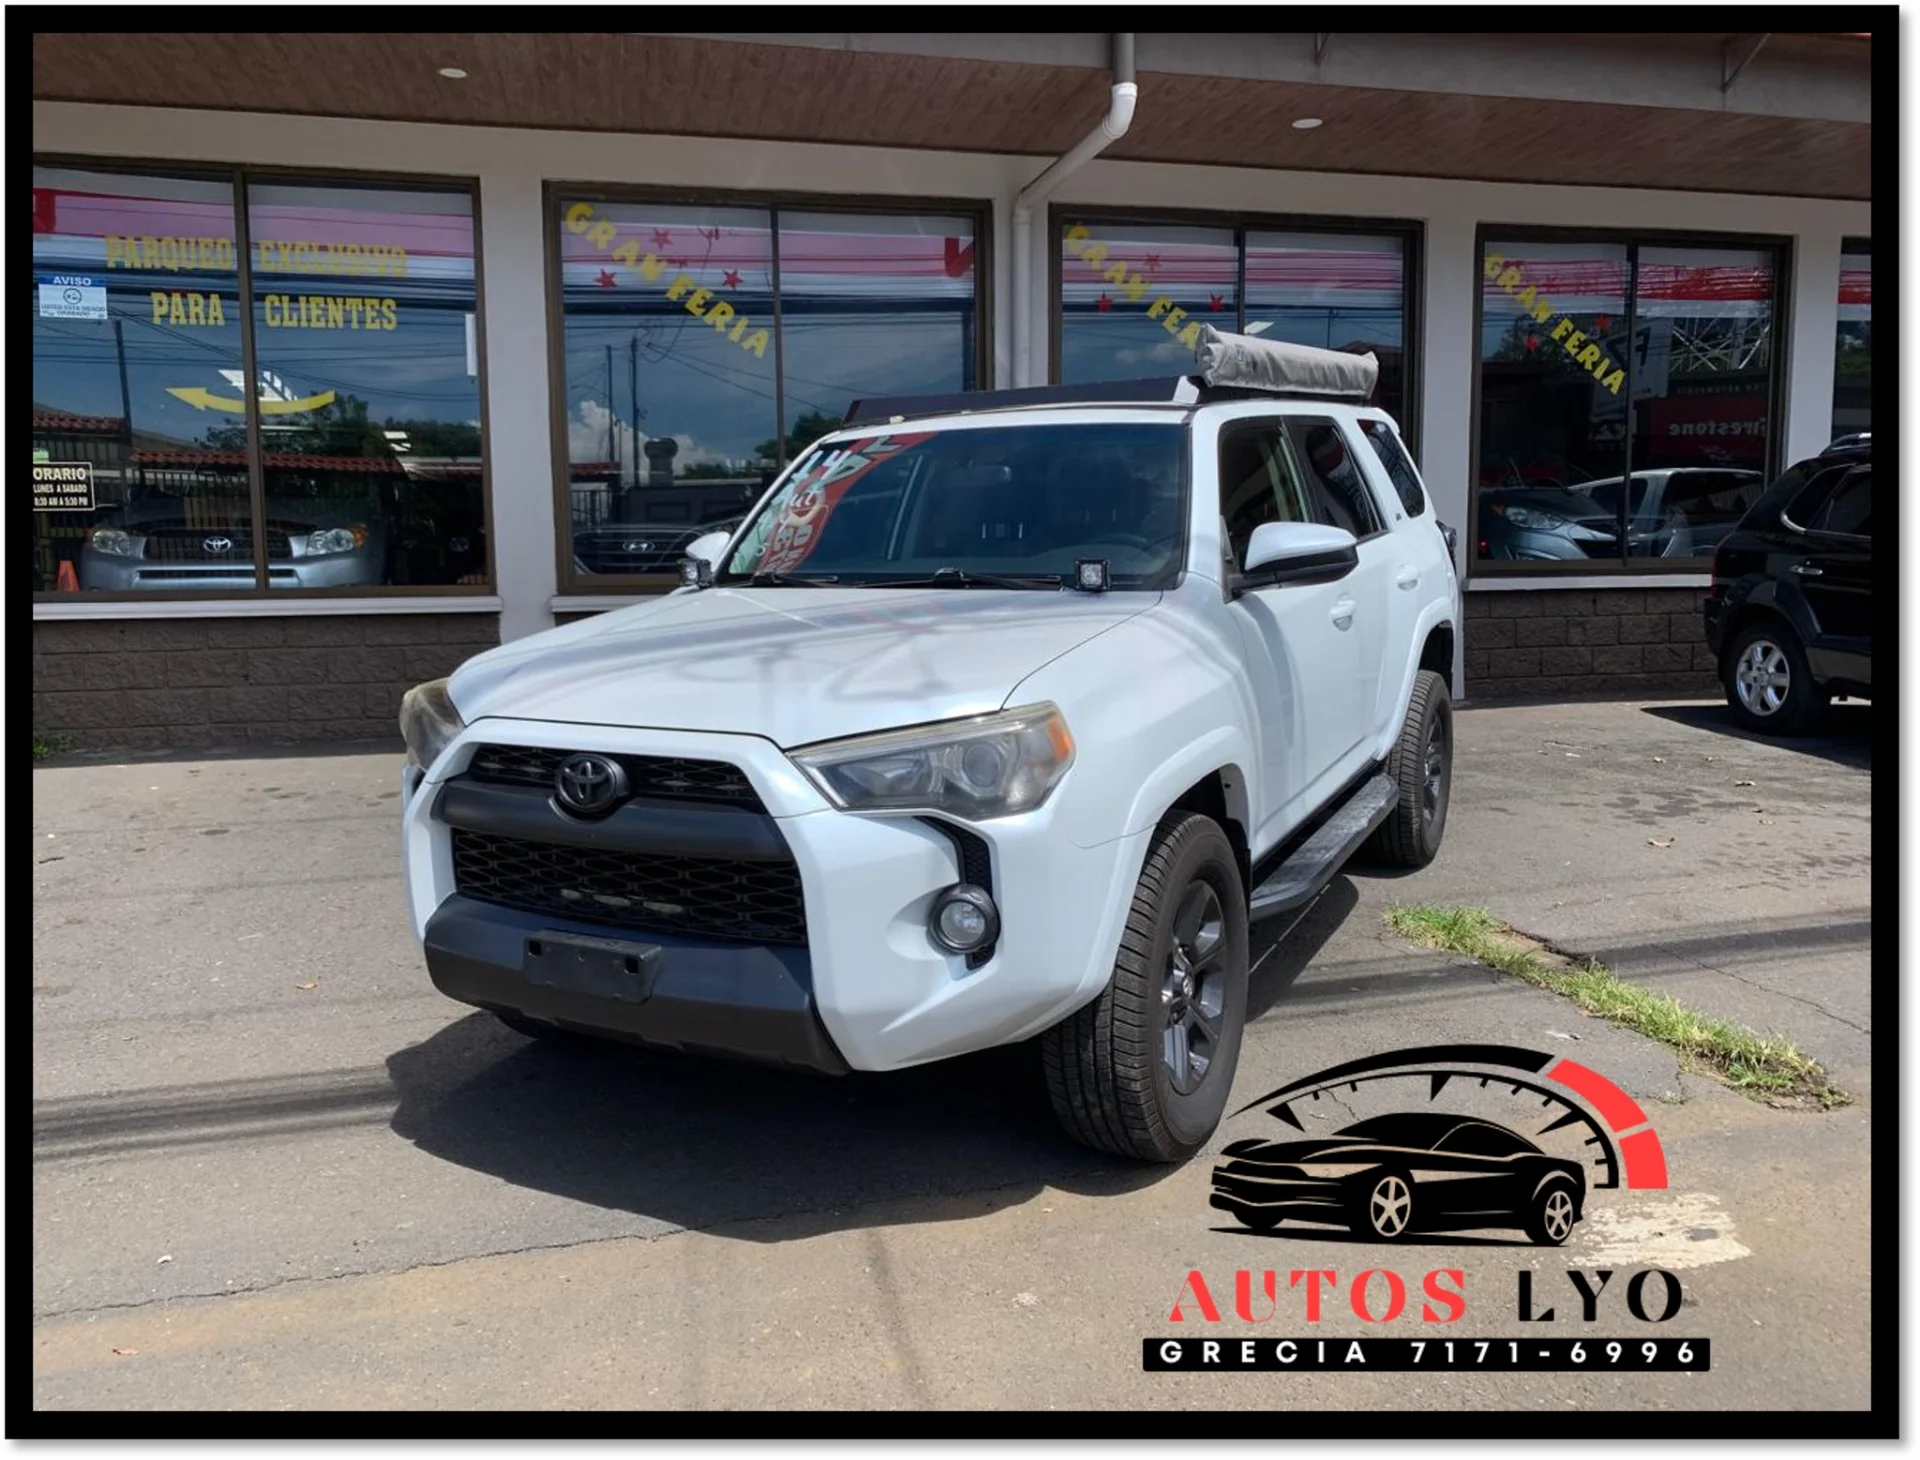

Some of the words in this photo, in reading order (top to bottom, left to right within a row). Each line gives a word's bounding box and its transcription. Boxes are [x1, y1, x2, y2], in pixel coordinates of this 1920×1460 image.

[106, 236, 233, 271] PARQUEO
[259, 240, 407, 277] EXCLUSIVO
[1066, 225, 1152, 302] GRAN
[52, 275, 92, 286] AVISO
[564, 203, 669, 281] GRAN
[666, 275, 768, 358] FERIA
[152, 293, 225, 325] PARA
[265, 295, 397, 330] CLIENTES
[1484, 253, 1556, 324] GRAN
[1551, 319, 1626, 394] FERIA
[33, 467, 86, 480] ORARIO
[33, 483, 54, 493] LUNES
[56, 483, 61, 493] A
[62, 483, 88, 493] SABADO
[48, 496, 58, 507] AM
[59, 496, 64, 507] A
[79, 496, 88, 507] PM
